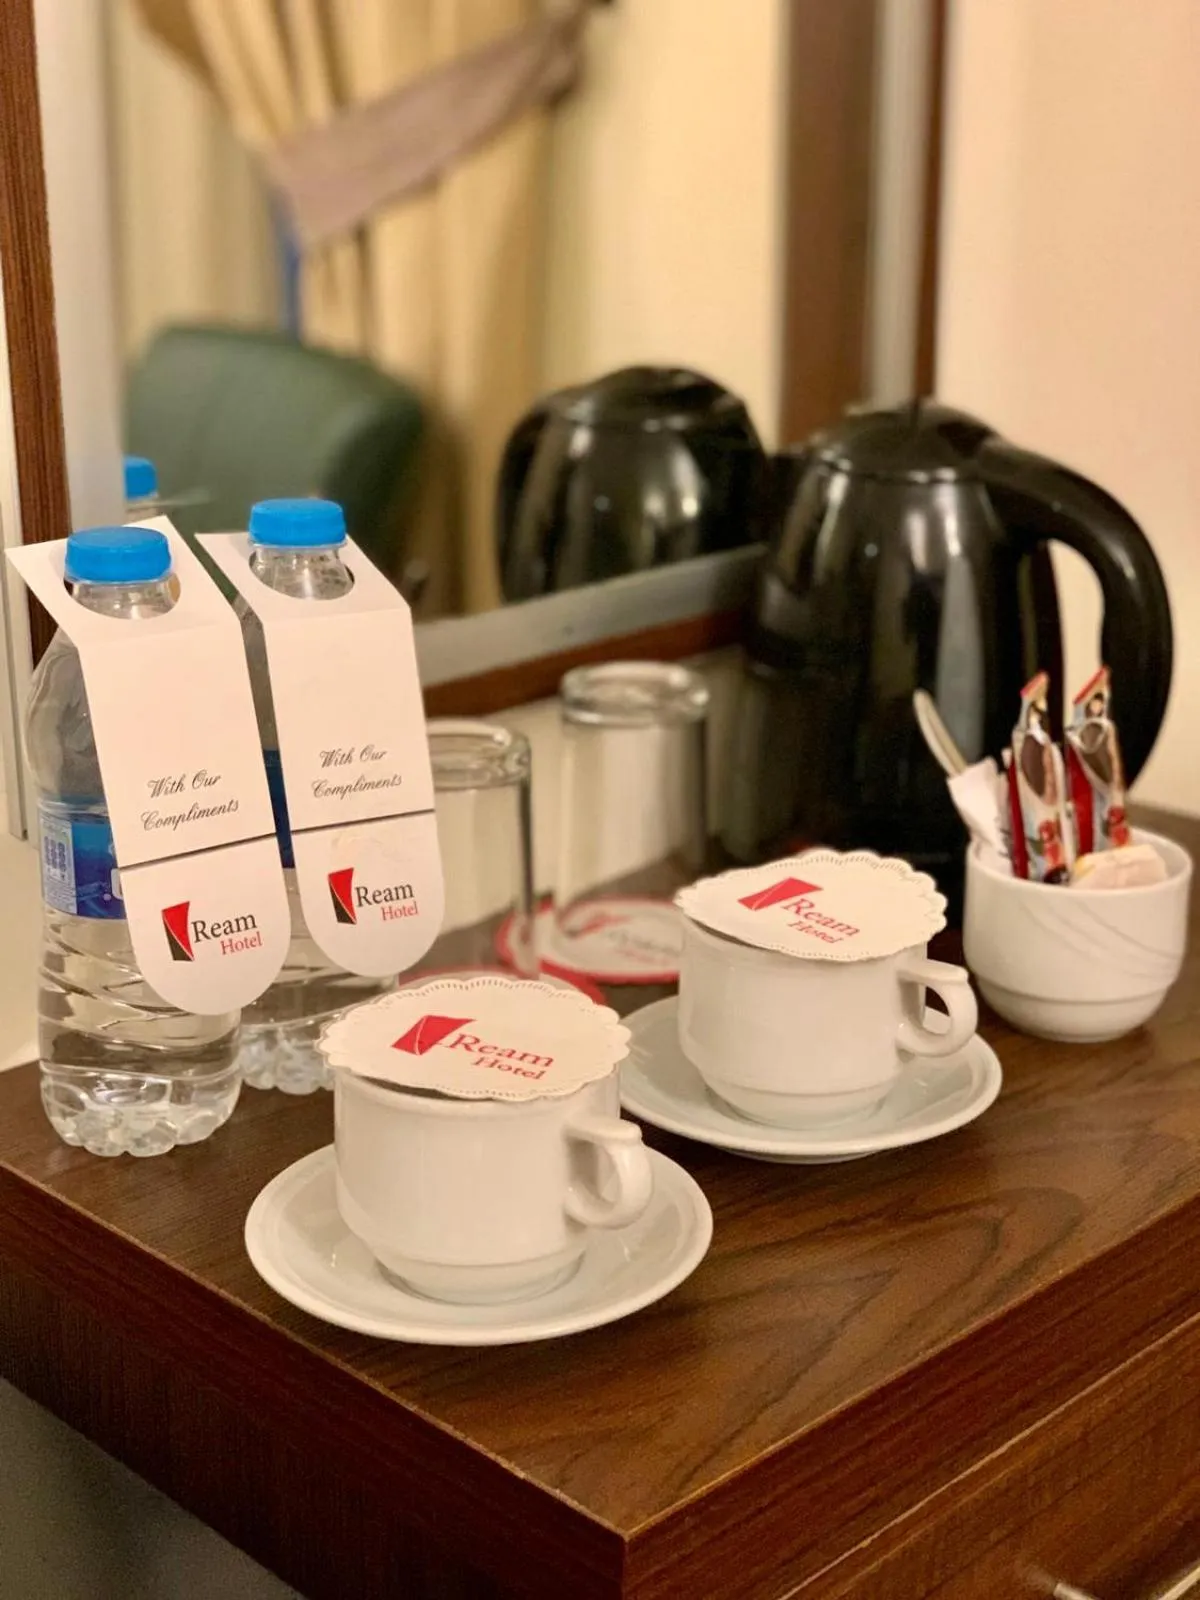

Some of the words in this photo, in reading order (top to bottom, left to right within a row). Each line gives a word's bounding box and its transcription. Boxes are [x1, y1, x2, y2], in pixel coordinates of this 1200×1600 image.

[319, 750, 353, 768] With
[359, 744, 386, 761] Our
[148, 779, 185, 798] With
[191, 769, 220, 789] Our
[312, 774, 402, 799] Compliments
[141, 800, 239, 831] Compliments
[355, 883, 414, 908] Ream
[382, 902, 418, 921] Hotel
[783, 898, 860, 937] Ream
[191, 914, 257, 943] Ream
[787, 919, 844, 944] Hotel
[221, 932, 262, 956] Hotel
[447, 1033, 554, 1068] Ream
[471, 1056, 546, 1080] Hotel
